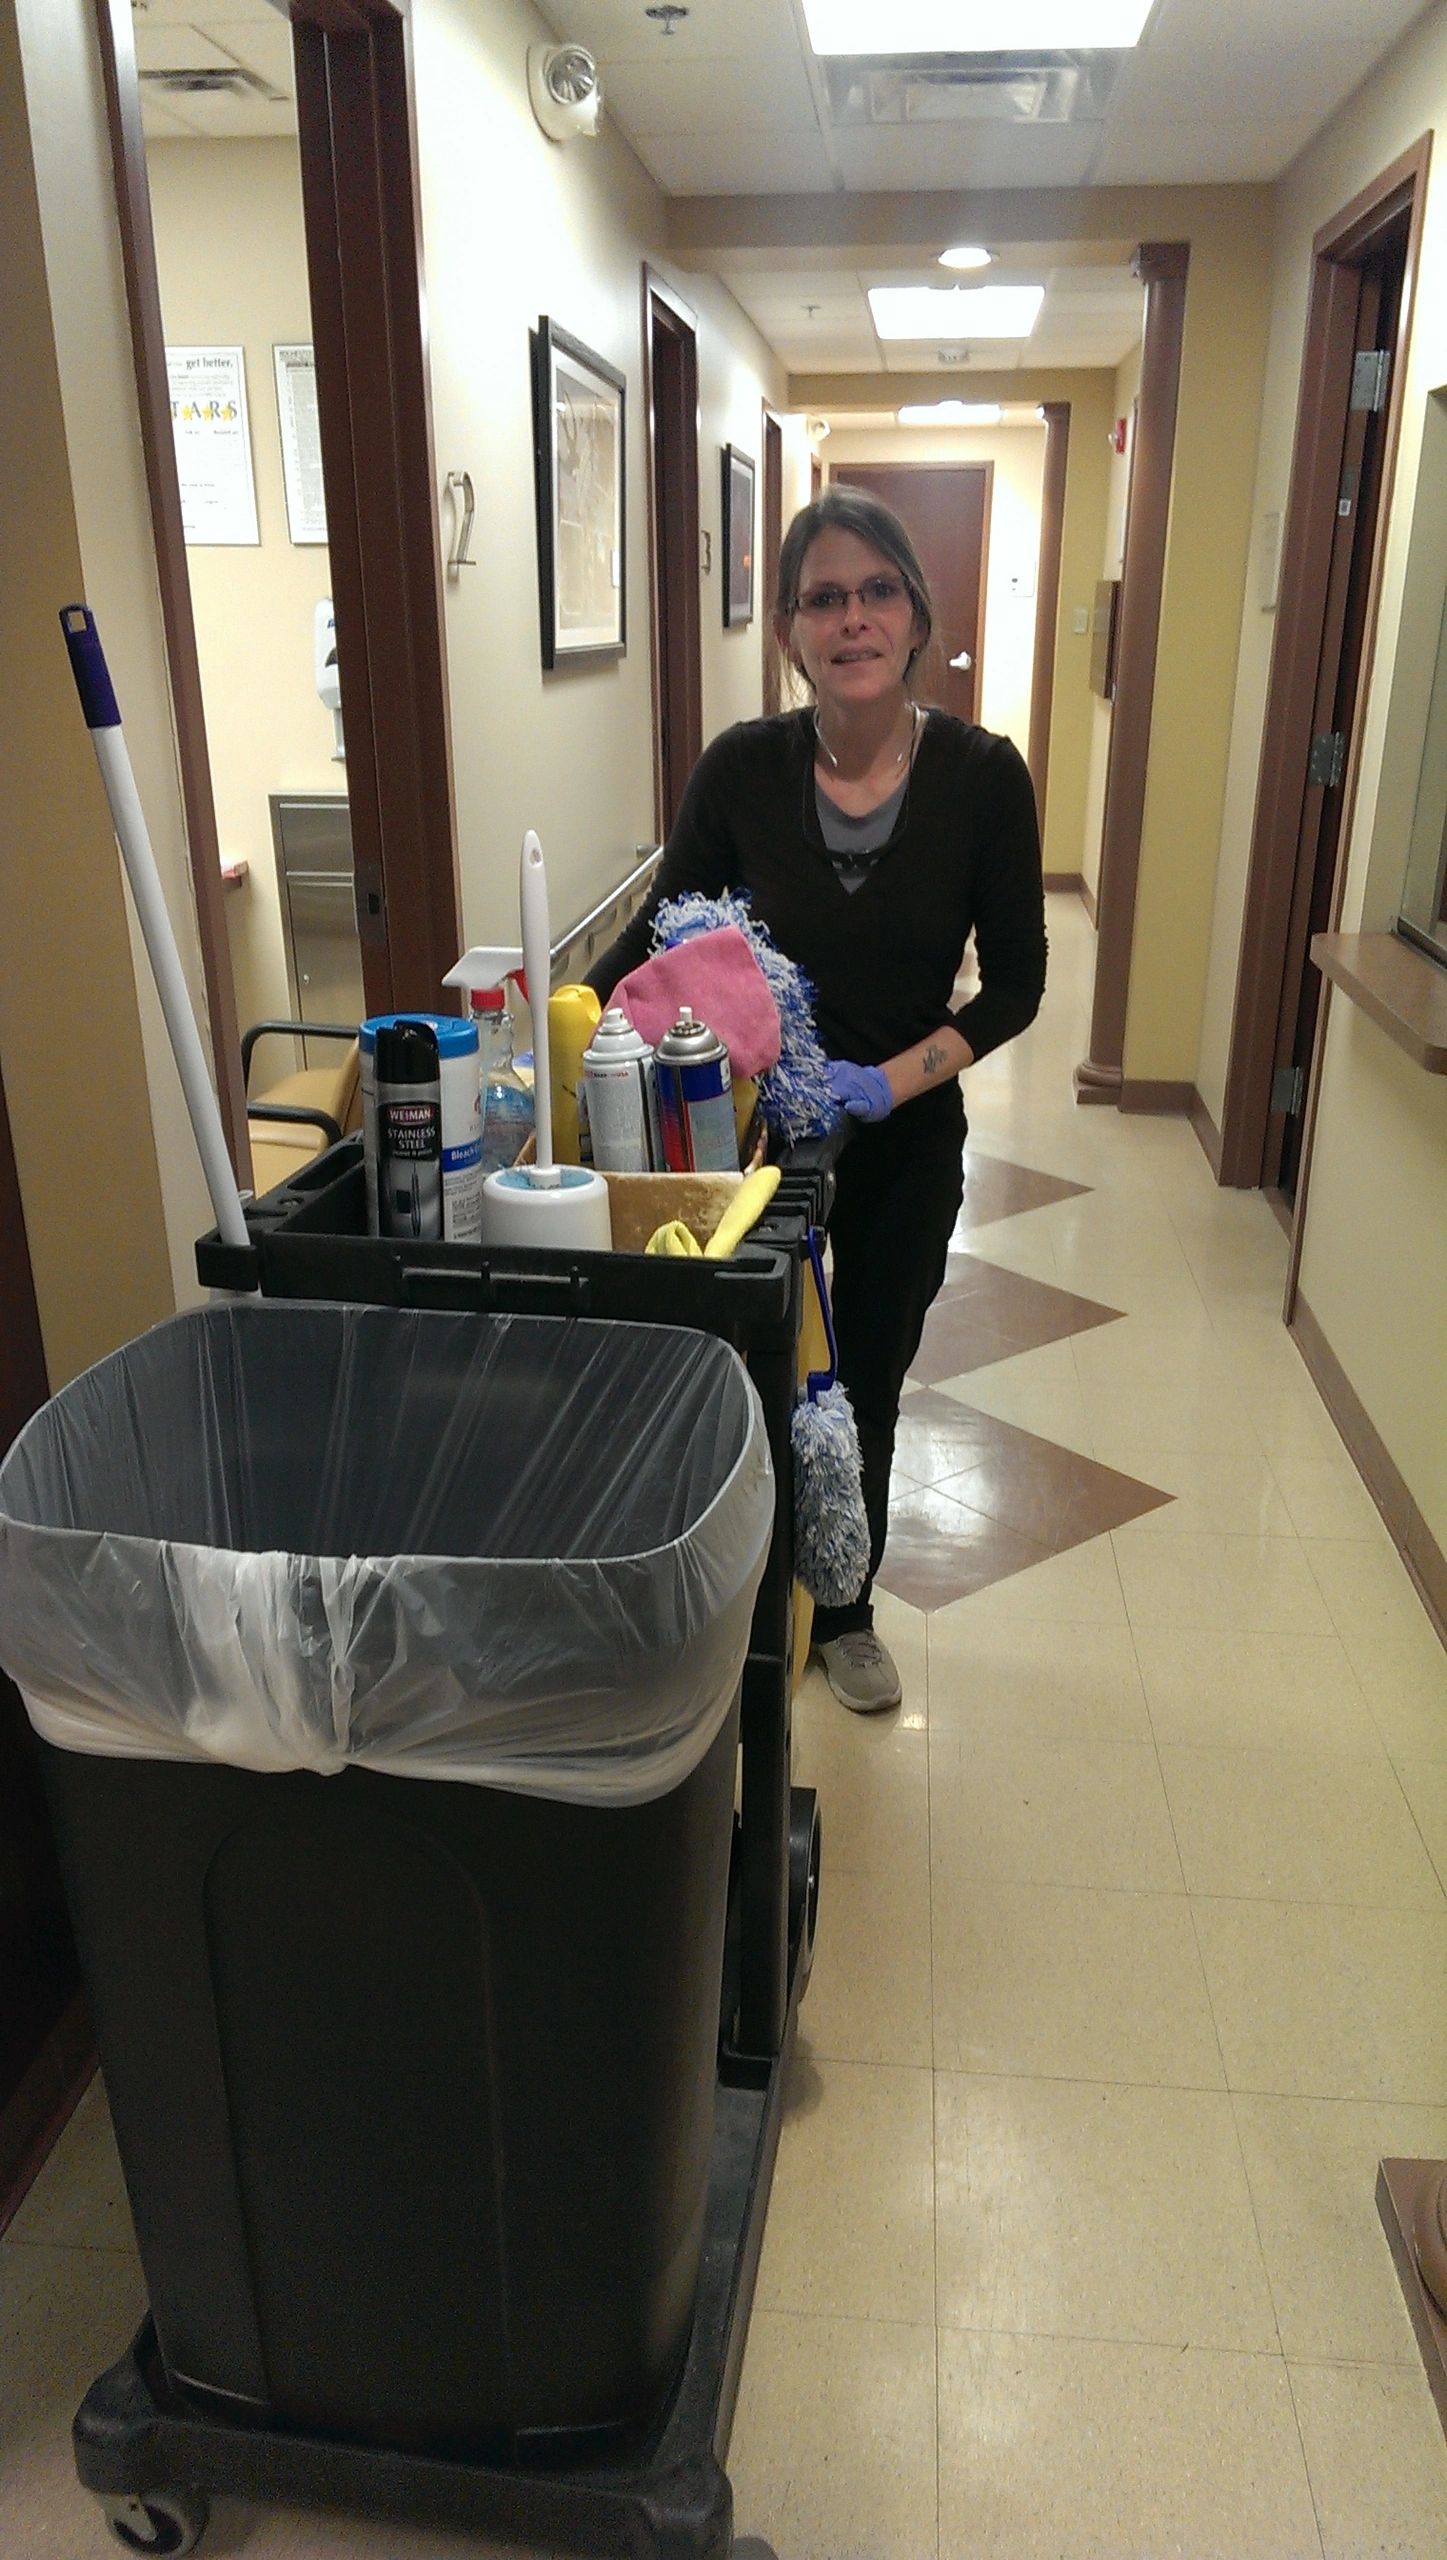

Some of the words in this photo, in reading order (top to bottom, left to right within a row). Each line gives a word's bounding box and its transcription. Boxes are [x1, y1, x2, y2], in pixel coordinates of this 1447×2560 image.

[445, 470, 476, 568] 2
[390, 1108, 431, 1121] WEIMAN
[387, 1126, 436, 1140] STAINLESS
[398, 1139, 426, 1150] STEEL
